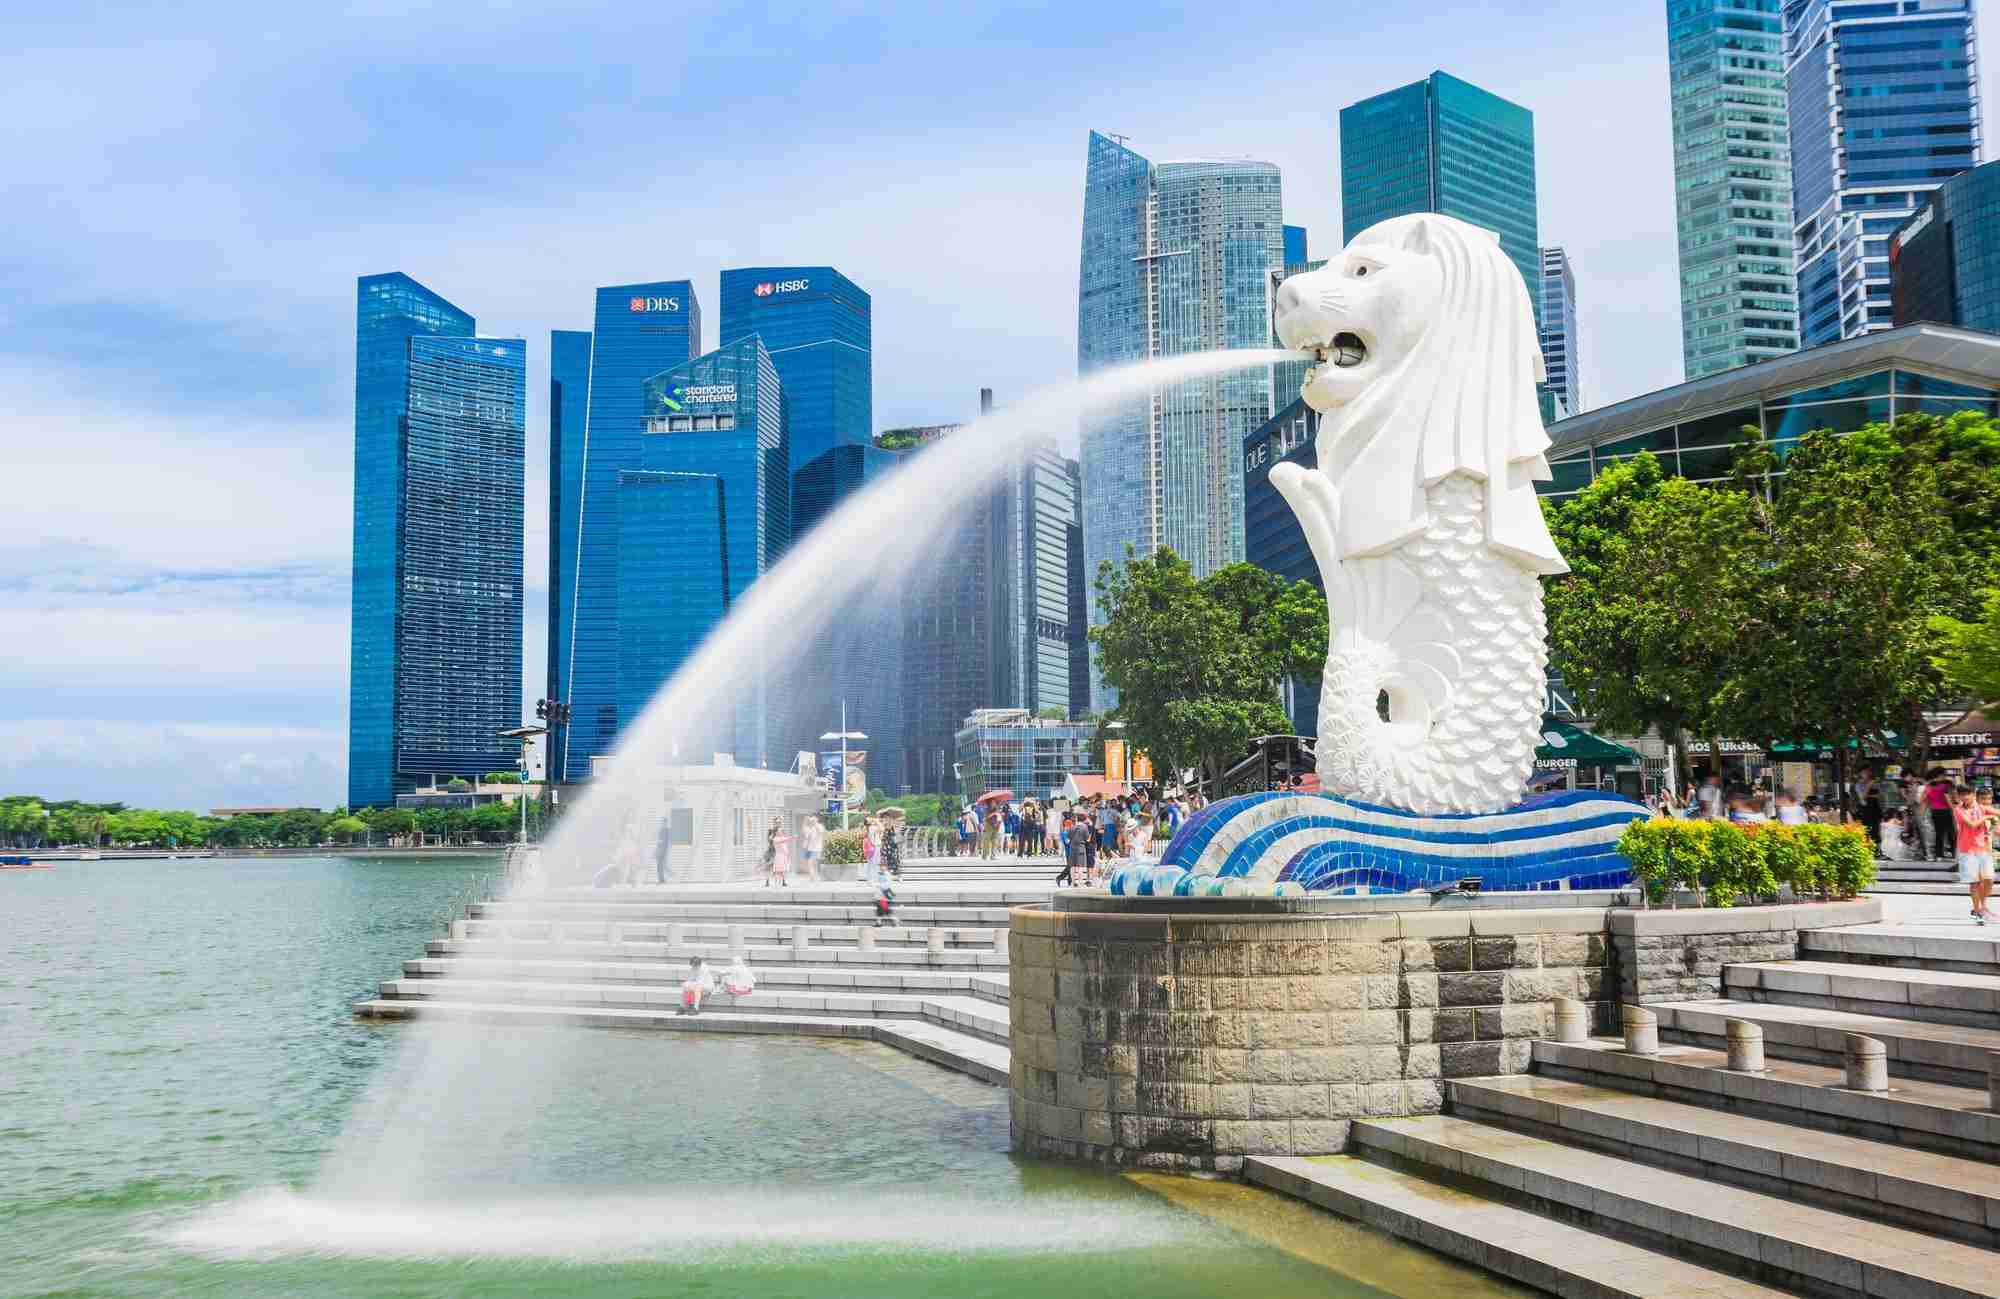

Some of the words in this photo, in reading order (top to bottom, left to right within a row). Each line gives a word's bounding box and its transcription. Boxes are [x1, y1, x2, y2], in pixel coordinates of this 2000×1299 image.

[776, 279, 809, 293] HSBC
[646, 297, 679, 311] DBS
[686, 384, 735, 395] standard
[686, 392, 737, 403] chartered
[1536, 759, 1578, 768] BURGER
